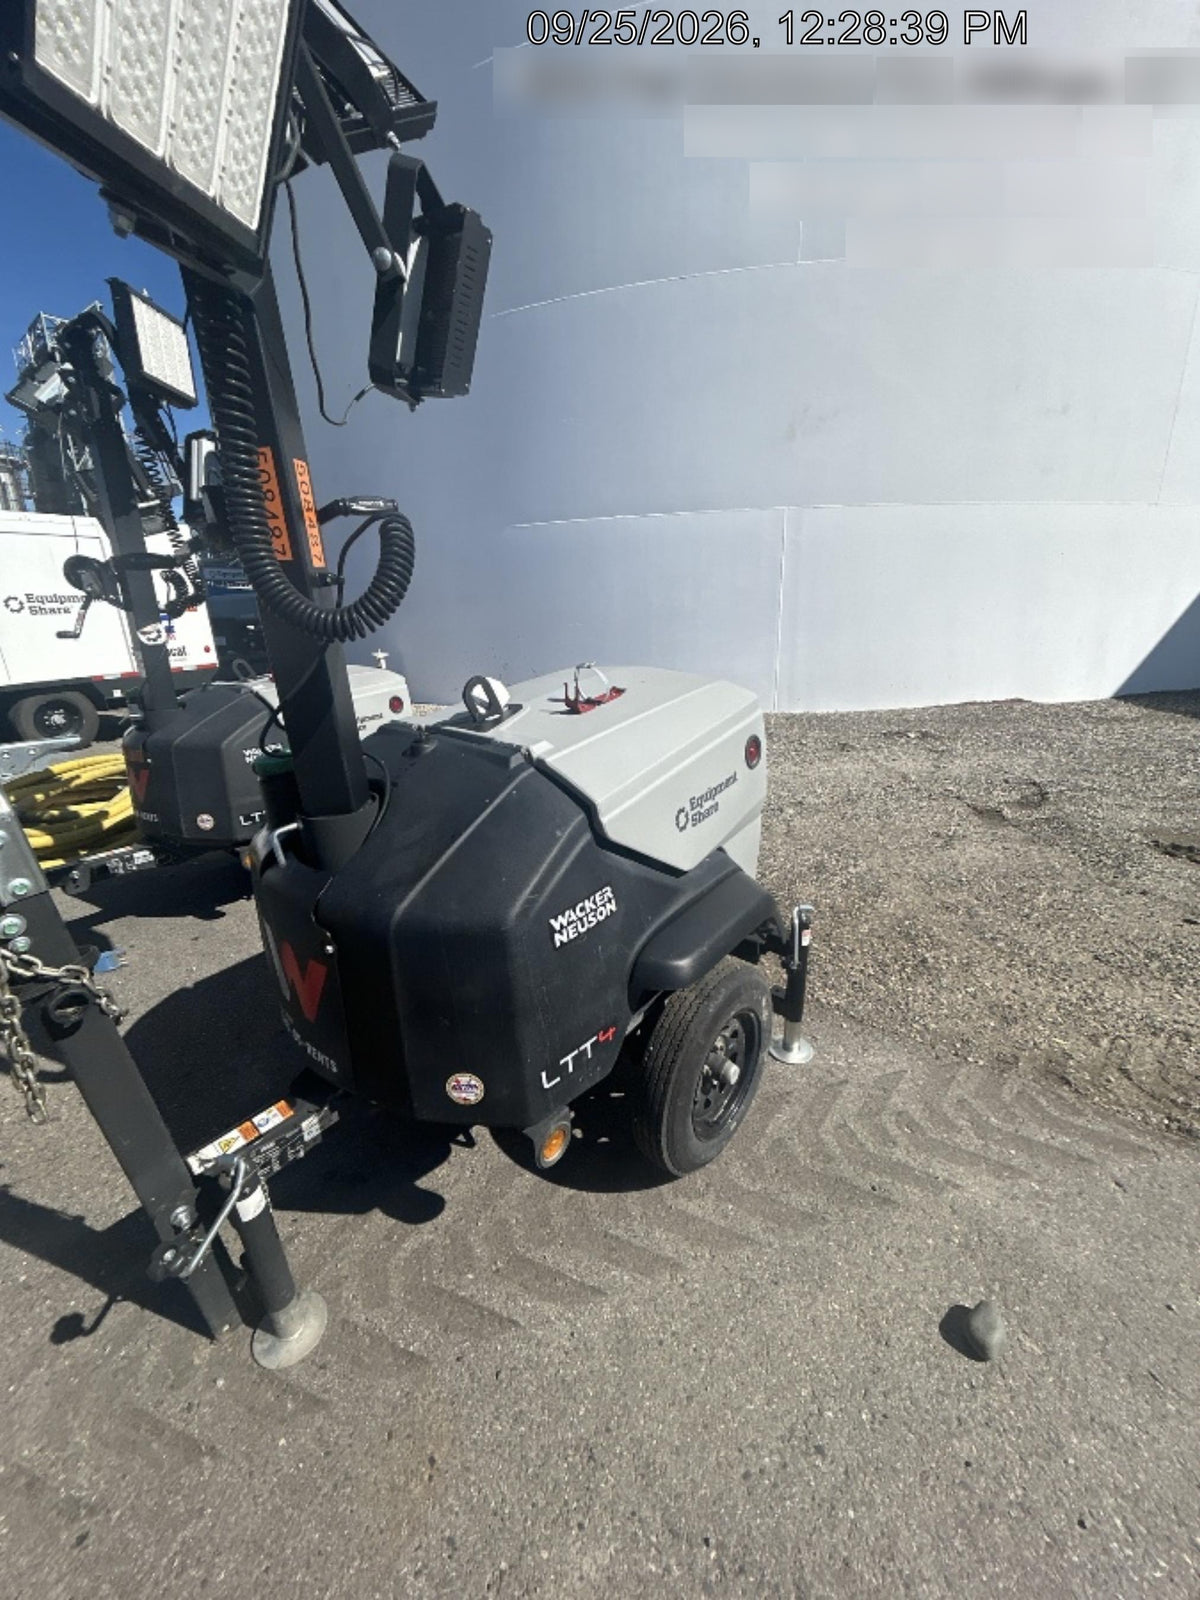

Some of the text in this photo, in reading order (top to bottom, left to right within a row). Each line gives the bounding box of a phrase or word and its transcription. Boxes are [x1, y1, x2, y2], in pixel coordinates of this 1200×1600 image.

[28, 605, 71, 615] Share
[691, 801, 719, 827] Share
[549, 886, 614, 931] WACKER
[554, 898, 617, 949] NEUSON
